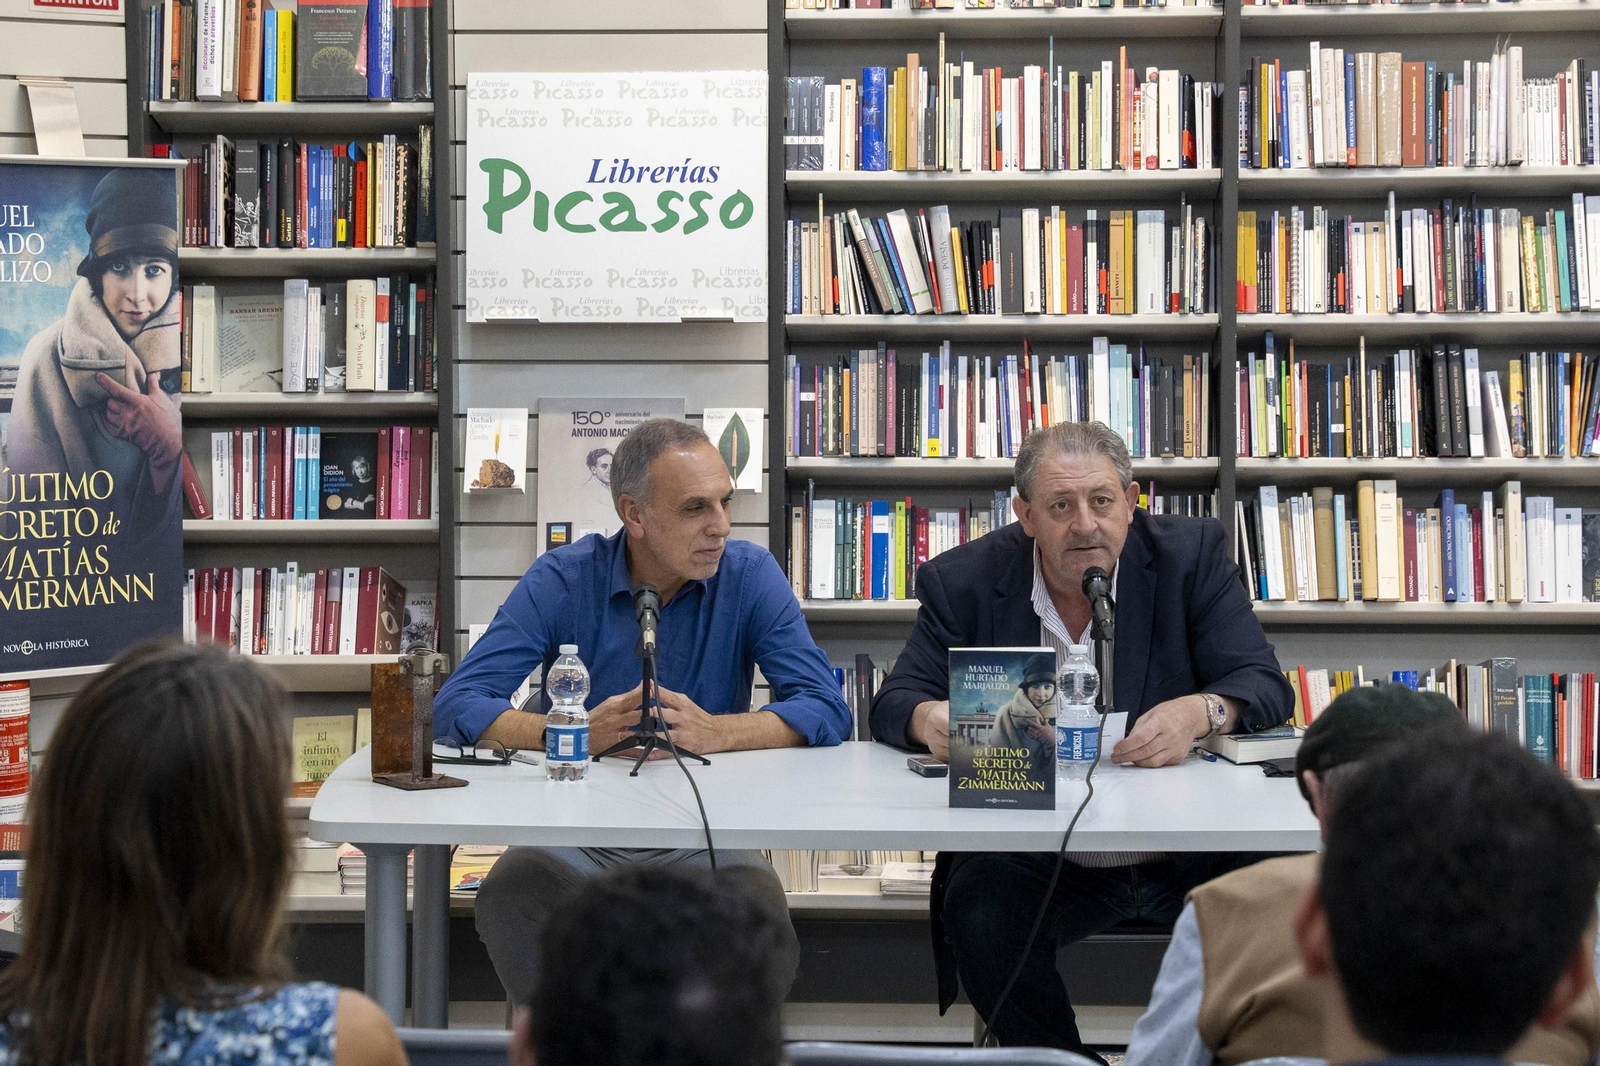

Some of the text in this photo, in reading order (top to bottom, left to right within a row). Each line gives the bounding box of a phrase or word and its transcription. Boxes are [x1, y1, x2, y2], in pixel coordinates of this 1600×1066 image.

[202, 28, 209, 36] de
[208, 45, 216, 65] dichos
[533, 80, 604, 100] Picasso
[617, 79, 688, 99] Picasso
[477, 108, 548, 128] Picasso
[562, 108, 633, 128] Picasso
[647, 107, 718, 128] Picasso
[586, 158, 721, 184] Librerías
[479, 157, 754, 235] Picasso
[522, 268, 593, 289] Picasso
[607, 268, 678, 289] Picasso
[692, 268, 763, 289] Picasso
[940, 240, 952, 301] BISHOP POESÍA
[551, 297, 623, 318] Picasso
[636, 297, 708, 318] Picasso
[356, 343, 364, 362] Sylvia
[571, 428, 608, 438] ANTONIO
[102, 511, 122, 536] de
[243, 599, 251, 629] NAVARRO
[45, 638, 90, 651] HISTÓRICA
[965, 674, 1008, 682] HURTADO
[968, 665, 1005, 674] MANUEL
[963, 682, 1010, 691] MARJALIZO
[317, 731, 327, 741] El
[1073, 730, 1083, 760] FUENCISLA
[303, 745, 340, 755] infinito
[984, 745, 1030, 758] ÚLTIMO
[972, 758, 1023, 769] SECRETO
[957, 777, 1045, 791] ZIMMERMANN
[976, 768, 1027, 781] MATÍAS
